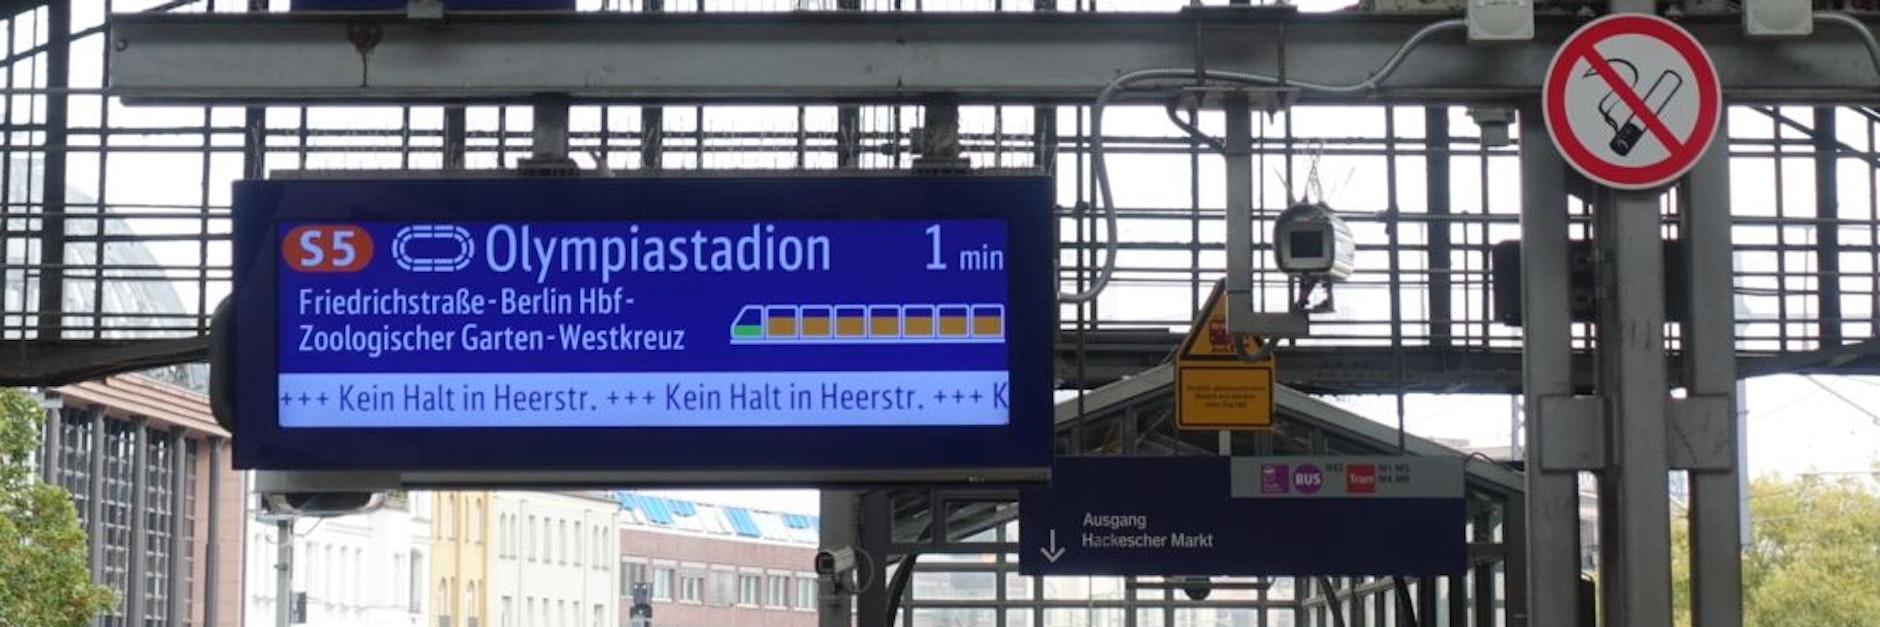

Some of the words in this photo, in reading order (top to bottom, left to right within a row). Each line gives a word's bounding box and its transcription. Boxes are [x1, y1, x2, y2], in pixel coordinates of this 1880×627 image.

[485, 223, 831, 284] Olympiastadion
[925, 223, 947, 270] 1
[959, 243, 1004, 270] min
[299, 323, 455, 358] Zoologischer
[340, 384, 394, 412] Kein
[403, 383, 455, 412] Halt
[463, 383, 485, 411] in
[494, 383, 597, 411] Heerstr.
[666, 382, 721, 411] Kein
[730, 382, 782, 410] Halt
[790, 382, 811, 410] in
[821, 381, 924, 410] Heerstr.
[1295, 472, 1321, 486] BUS
[1349, 472, 1374, 485] Tram
[1082, 511, 1147, 530] Ausgang
[1082, 532, 1166, 548] Hackescher
[1171, 532, 1213, 548] Markt
